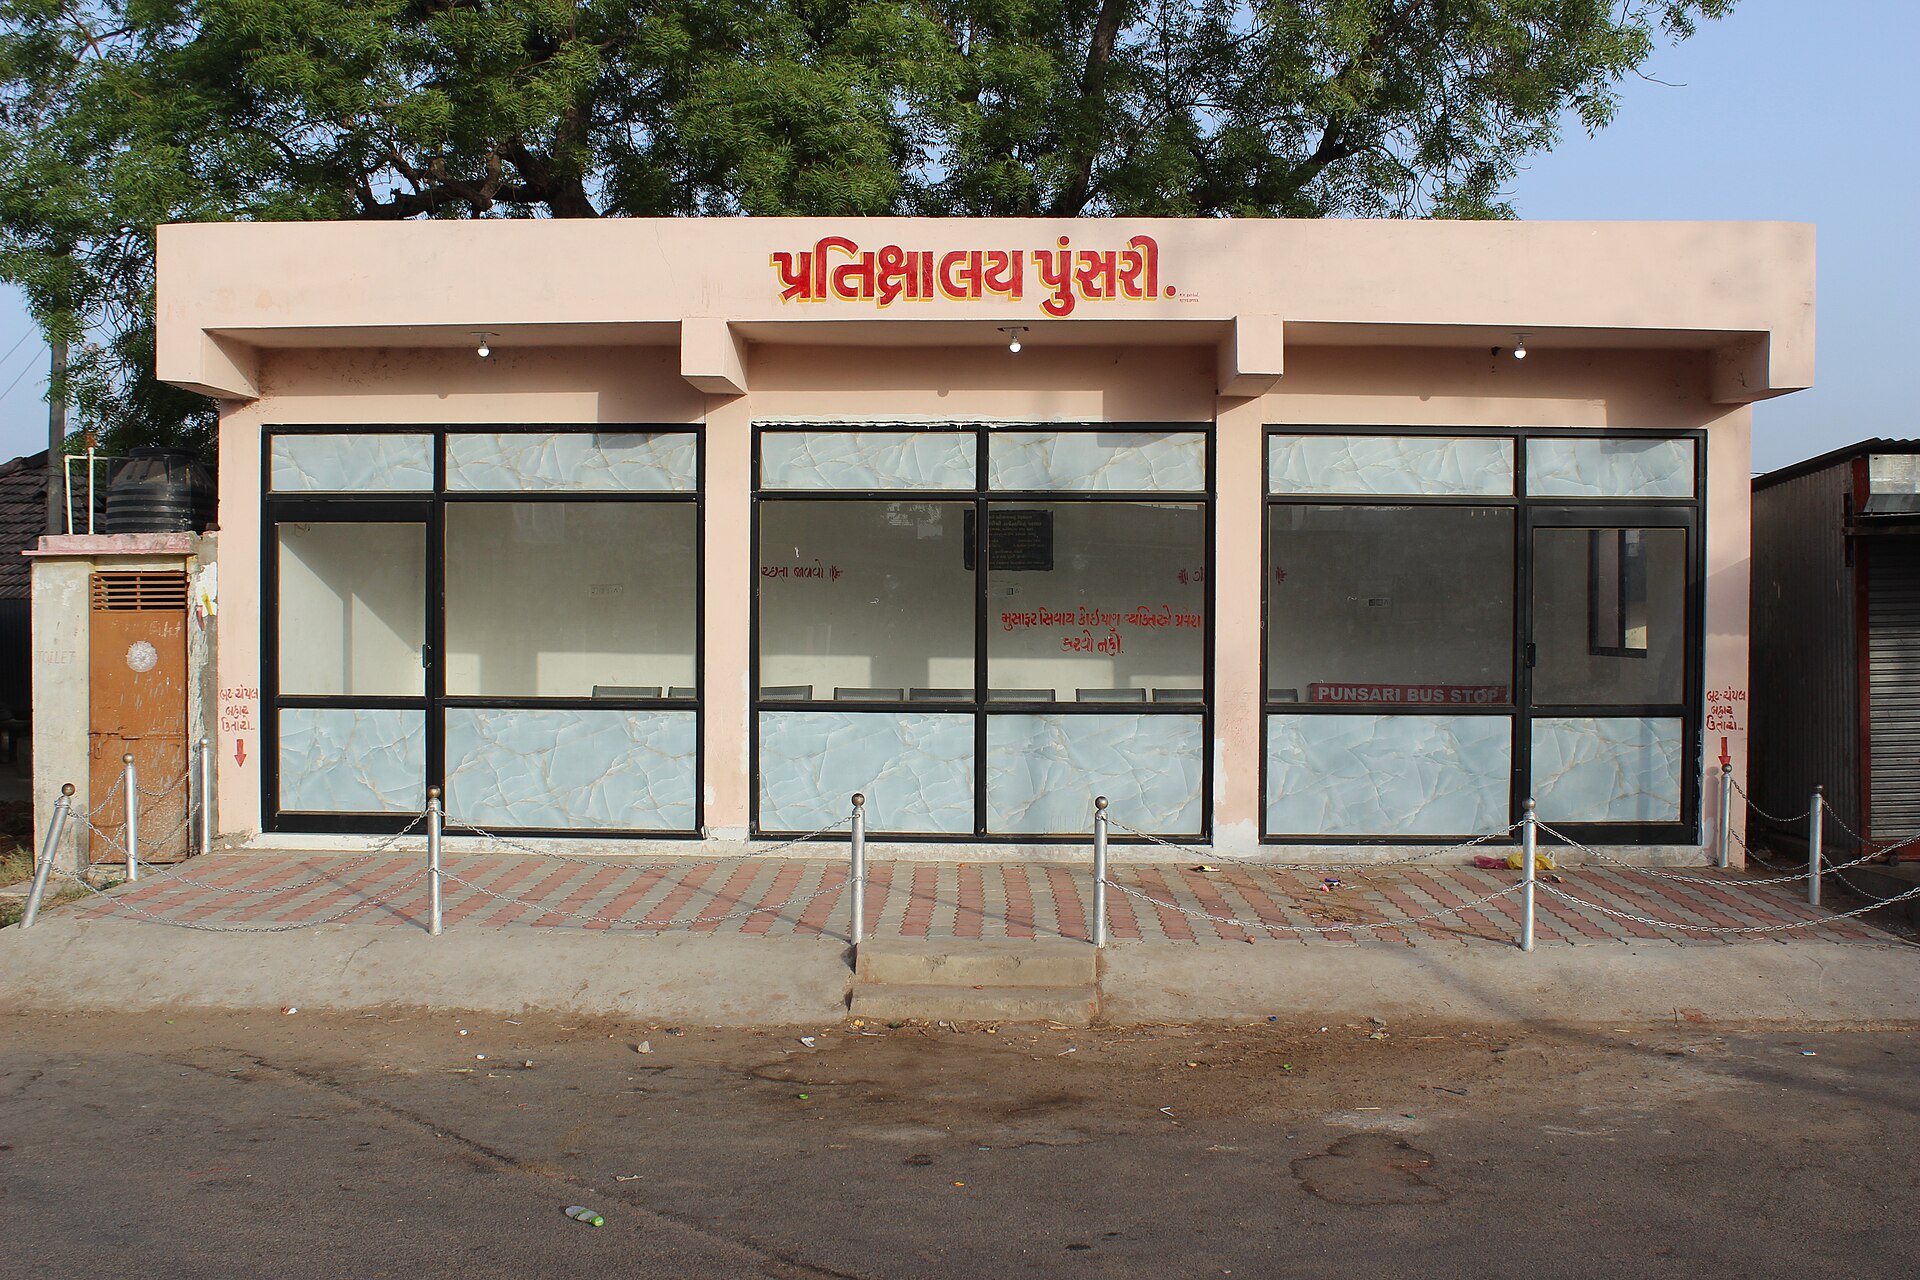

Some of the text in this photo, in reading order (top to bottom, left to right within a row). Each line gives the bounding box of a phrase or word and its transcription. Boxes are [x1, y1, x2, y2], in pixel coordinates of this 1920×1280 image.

[1038, 606, 1075, 626] સિવાય
[37, 650, 76, 664] TOILET
[1317, 686, 1498, 703] PUNSARI BUS STOP
